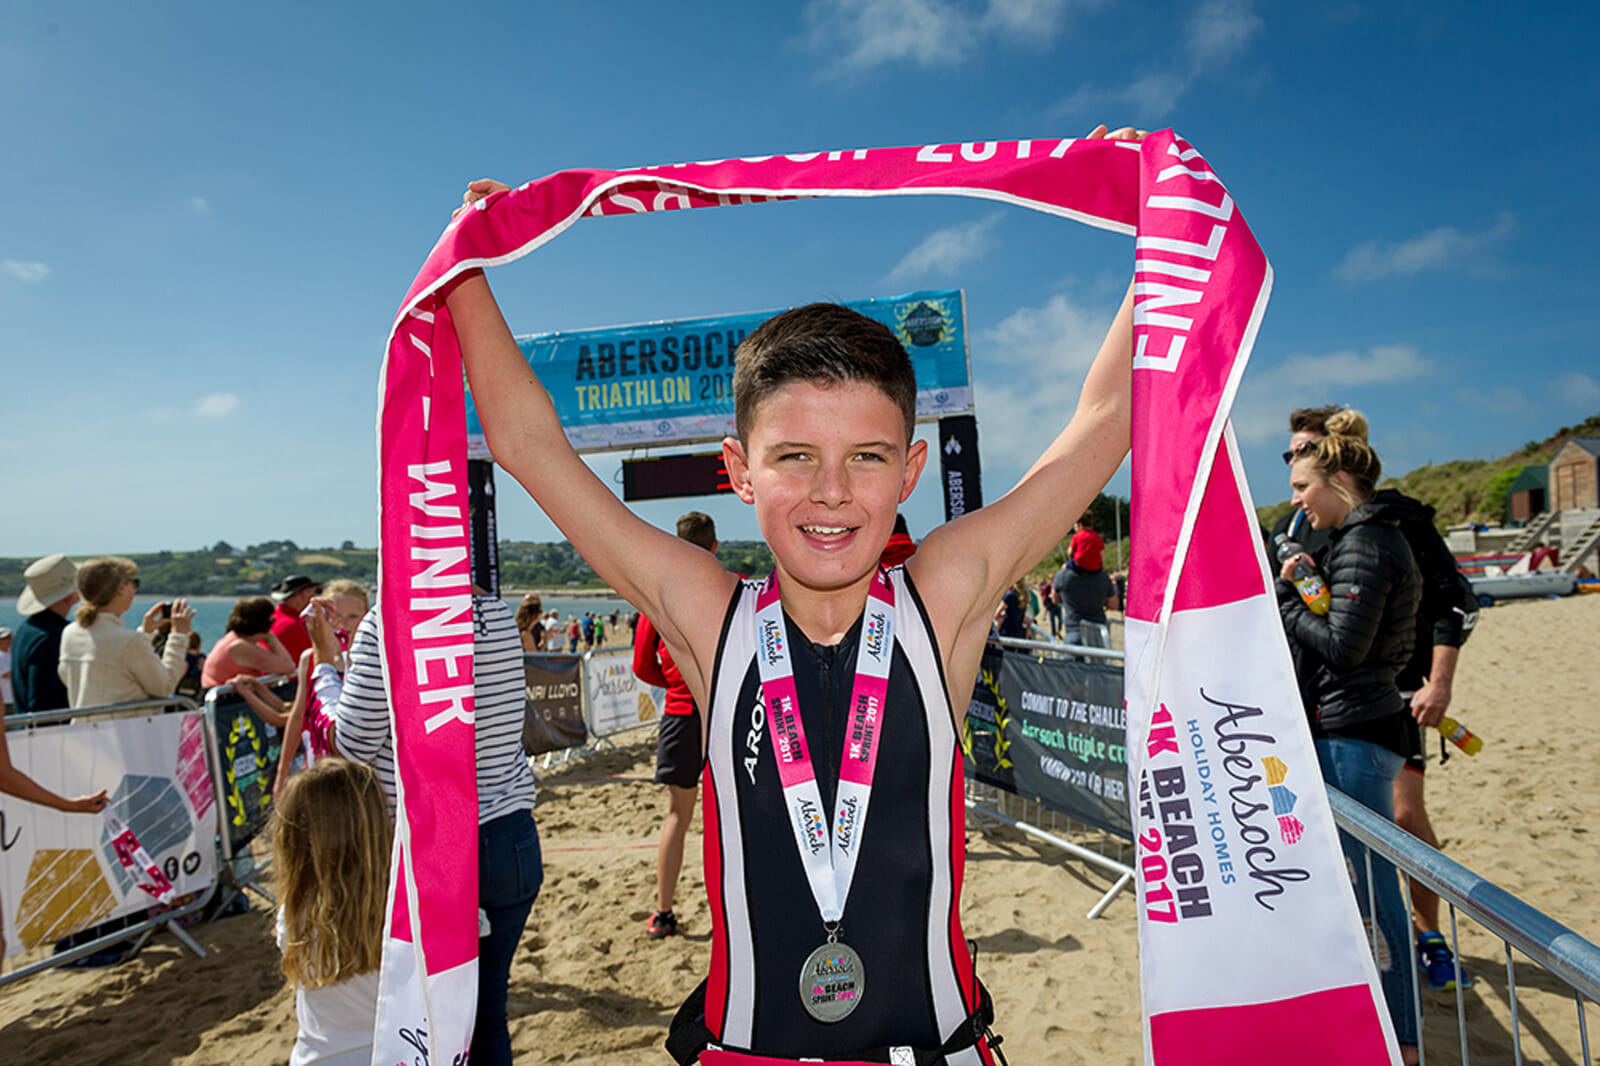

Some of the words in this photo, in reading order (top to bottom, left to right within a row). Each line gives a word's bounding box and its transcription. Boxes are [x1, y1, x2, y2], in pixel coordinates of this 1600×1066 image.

[575, 329, 745, 381] ABERSOCH
[575, 376, 691, 411] TRIATHLON
[700, 373, 735, 400] 201
[407, 460, 476, 734] WINNER
[763, 619, 784, 666] Abersoch
[866, 612, 886, 663] Abersoch
[770, 696, 787, 736] SPRINT
[781, 695, 793, 713] 1K
[852, 694, 869, 741] BEACH
[866, 695, 879, 723] 2017
[1021, 690, 1055, 717] COMMIT
[1056, 697, 1069, 719] TO
[1069, 699, 1087, 723] THE
[778, 737, 793, 763] 2017
[784, 713, 805, 761] BEACH
[848, 742, 861, 760] 1K
[860, 723, 875, 763] SPRINT
[1067, 731, 1106, 763] triple
[1147, 702, 1180, 759] 1K
[1187, 719, 1216, 805] HOLIDAY
[1207, 812, 1237, 885] HOMES
[1200, 687, 1311, 912] Abersoch
[796, 796, 825, 857] Abersoch
[1152, 766, 1213, 920] BEACH
[1138, 827, 1179, 924] 2017
[824, 981, 855, 993] BEACH
[835, 989, 856, 1002] 2017
